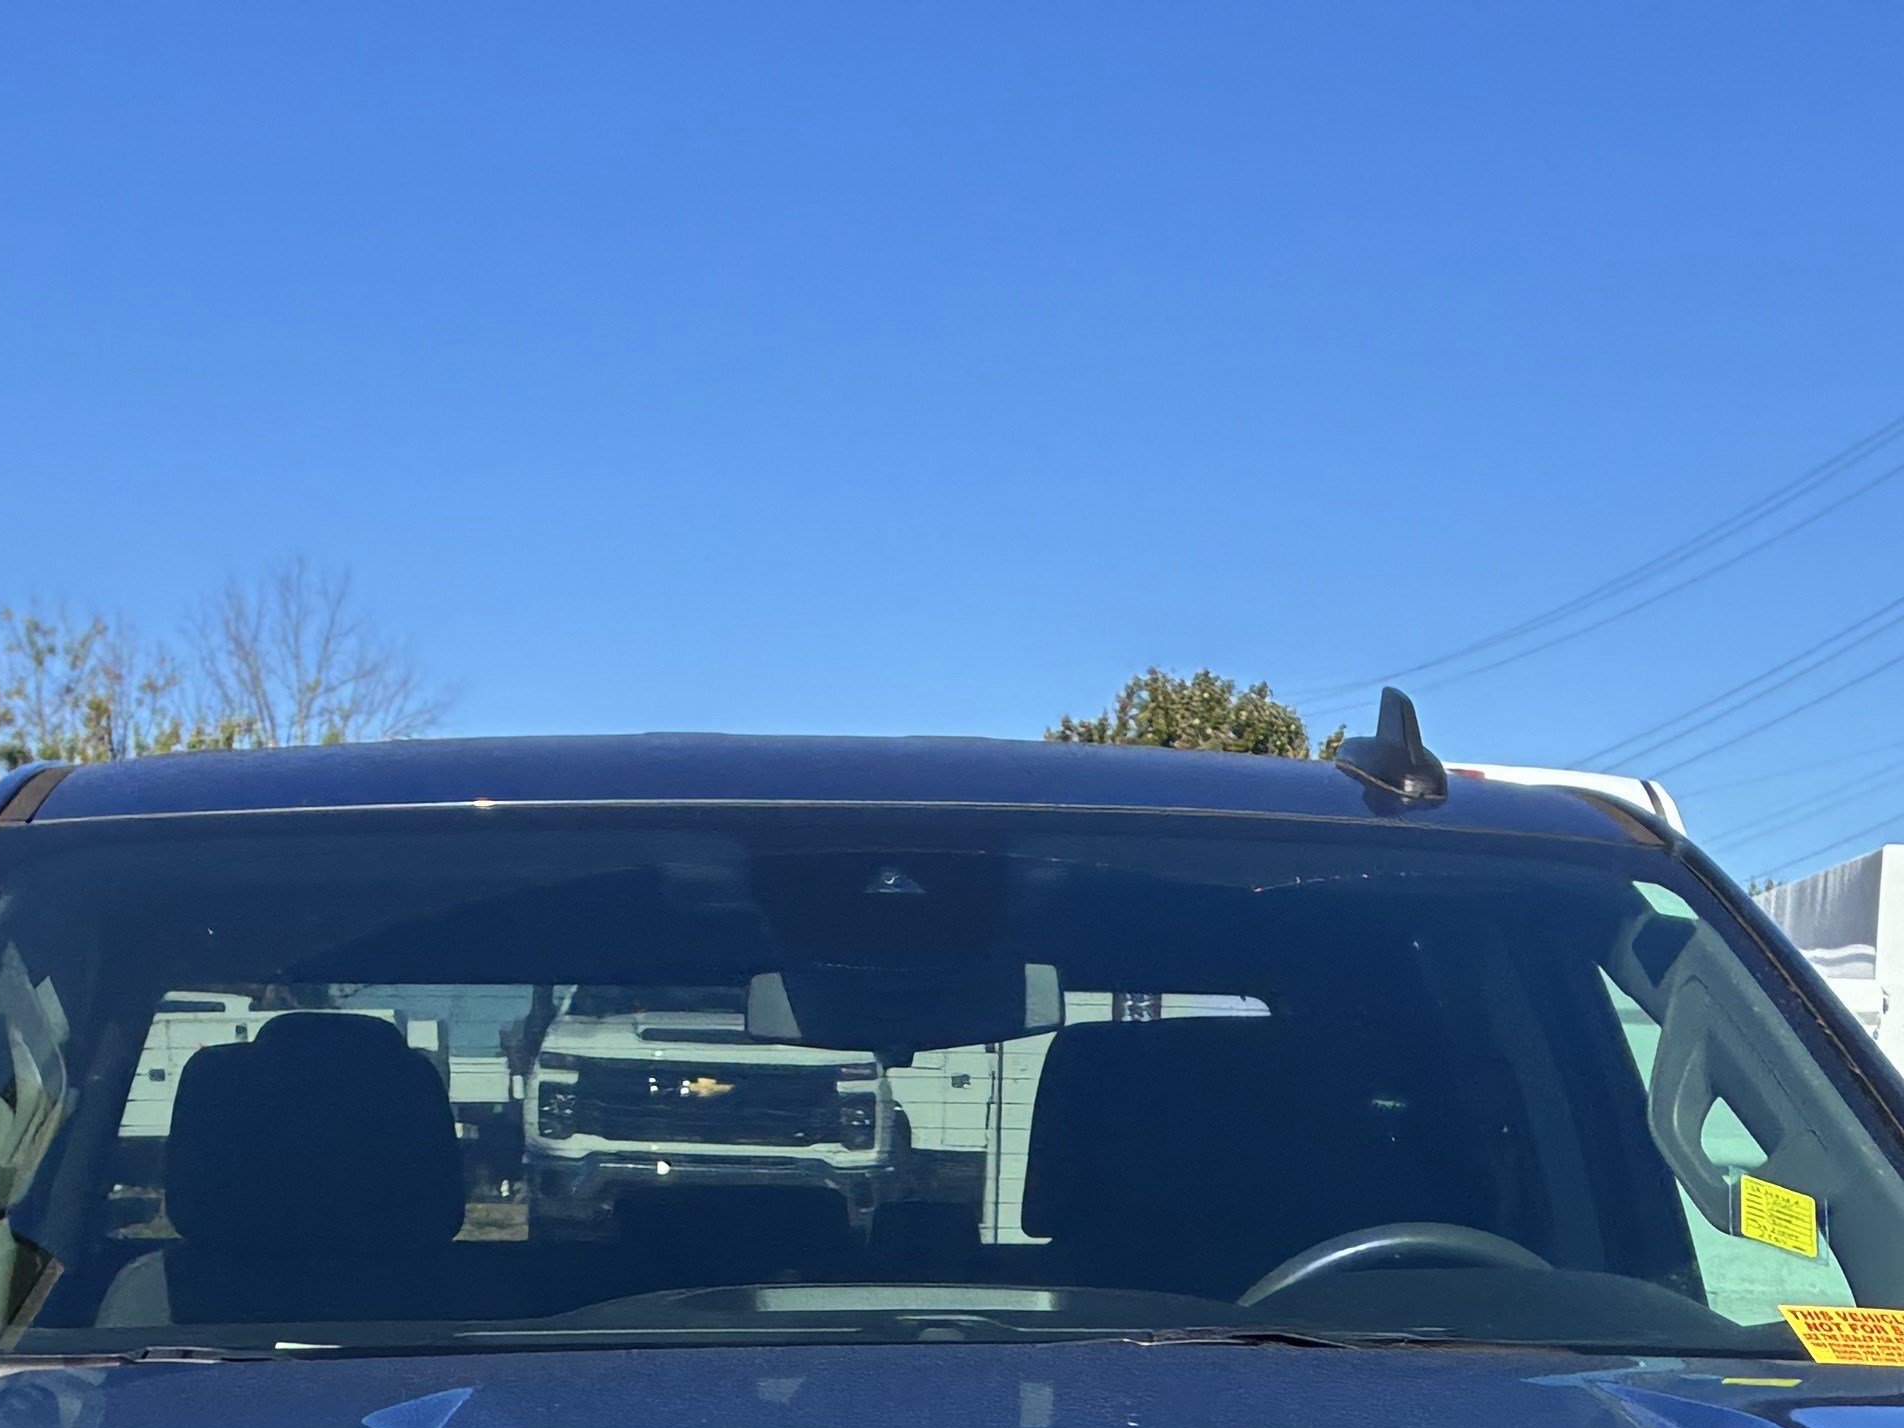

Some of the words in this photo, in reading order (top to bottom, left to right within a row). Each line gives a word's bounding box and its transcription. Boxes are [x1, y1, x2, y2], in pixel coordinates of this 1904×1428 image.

[1787, 1310, 1834, 1322] THIS
[1804, 1321, 1843, 1333] NOT
[1848, 1323, 1889, 1335] FOR
